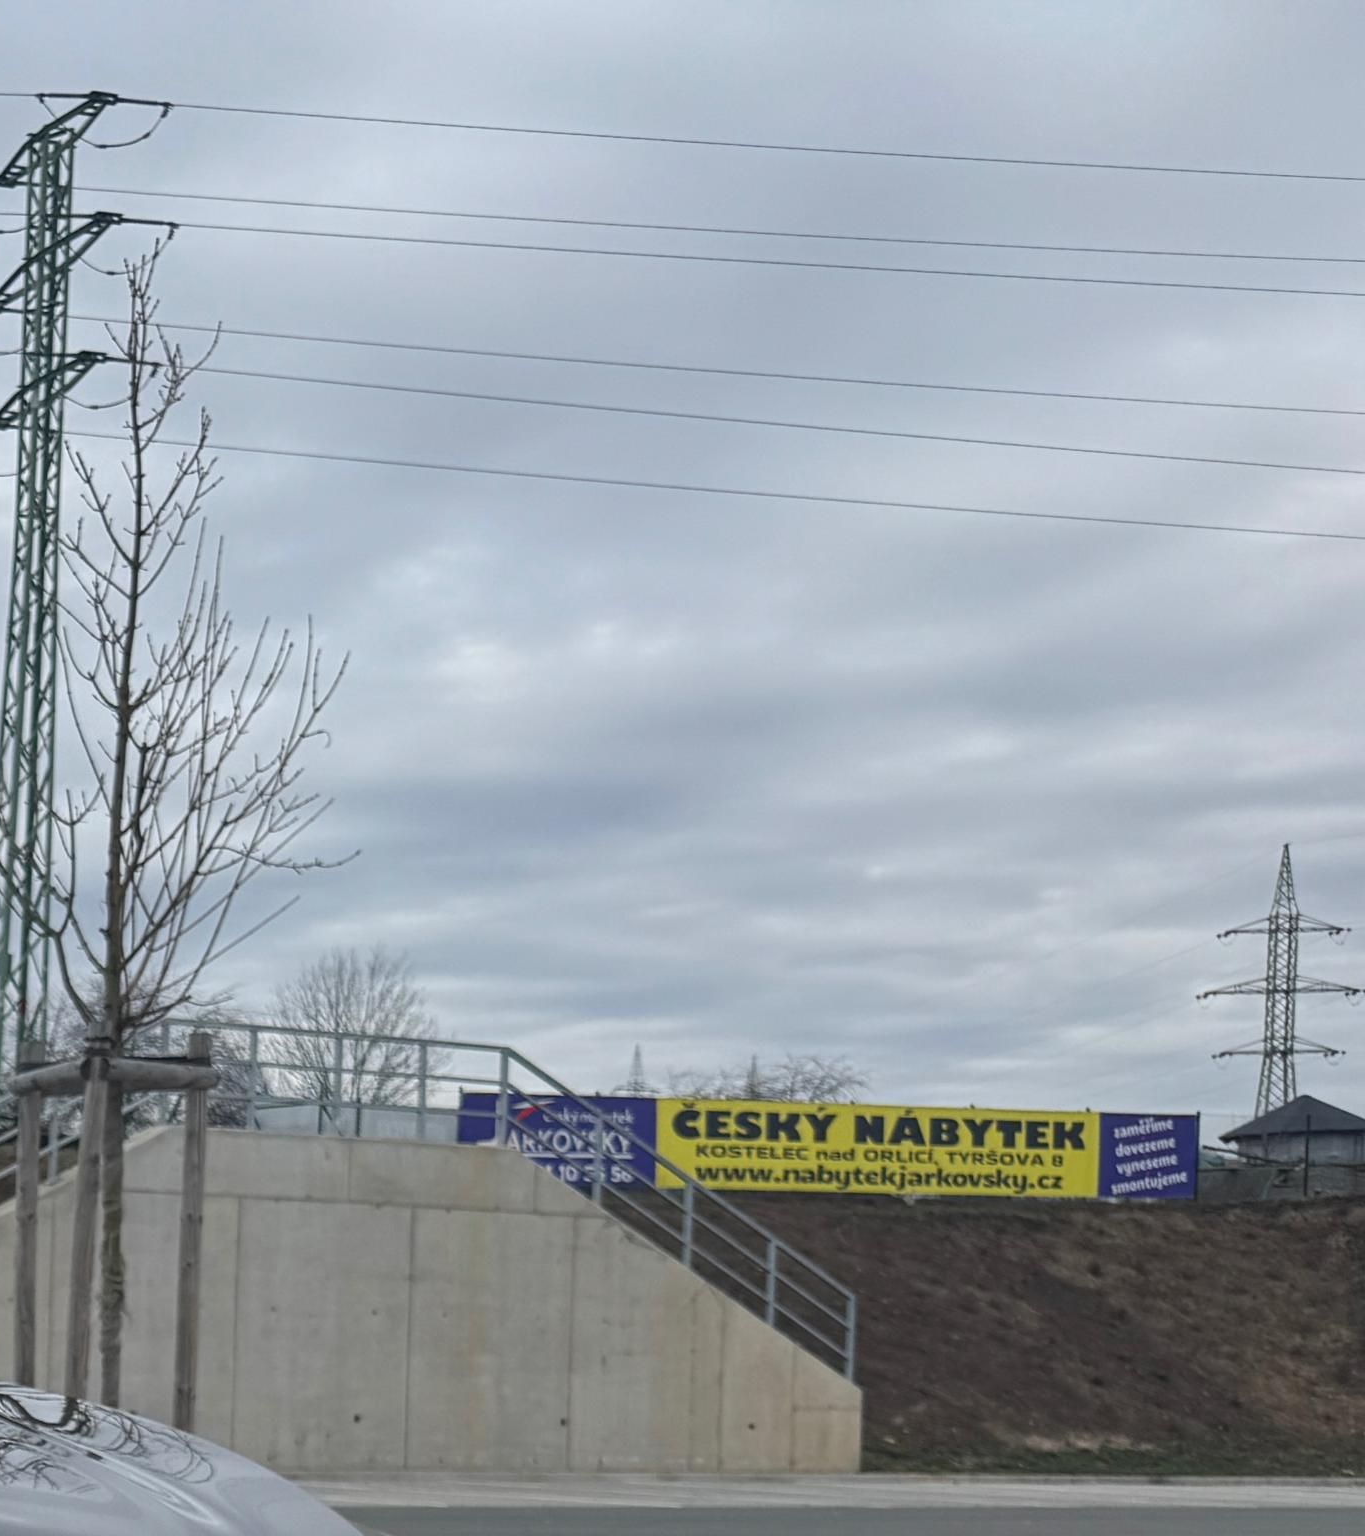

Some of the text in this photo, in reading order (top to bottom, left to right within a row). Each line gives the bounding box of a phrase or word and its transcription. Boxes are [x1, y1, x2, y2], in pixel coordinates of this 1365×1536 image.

[671, 1102, 1086, 1150] ČESKÝ NÁBYTEK
[695, 1144, 810, 1161] KOSTELEC
[815, 1147, 856, 1162] nad
[947, 1150, 1045, 1167] TYRŠOVA
[1052, 1154, 1064, 1168] 8
[1115, 1138, 1176, 1158] dovezeme
[1115, 1154, 1178, 1177] vyneseme
[695, 1165, 1064, 1194] www.nabytekjarkovsky.cz
[1110, 1171, 1188, 1195] smontujeme
